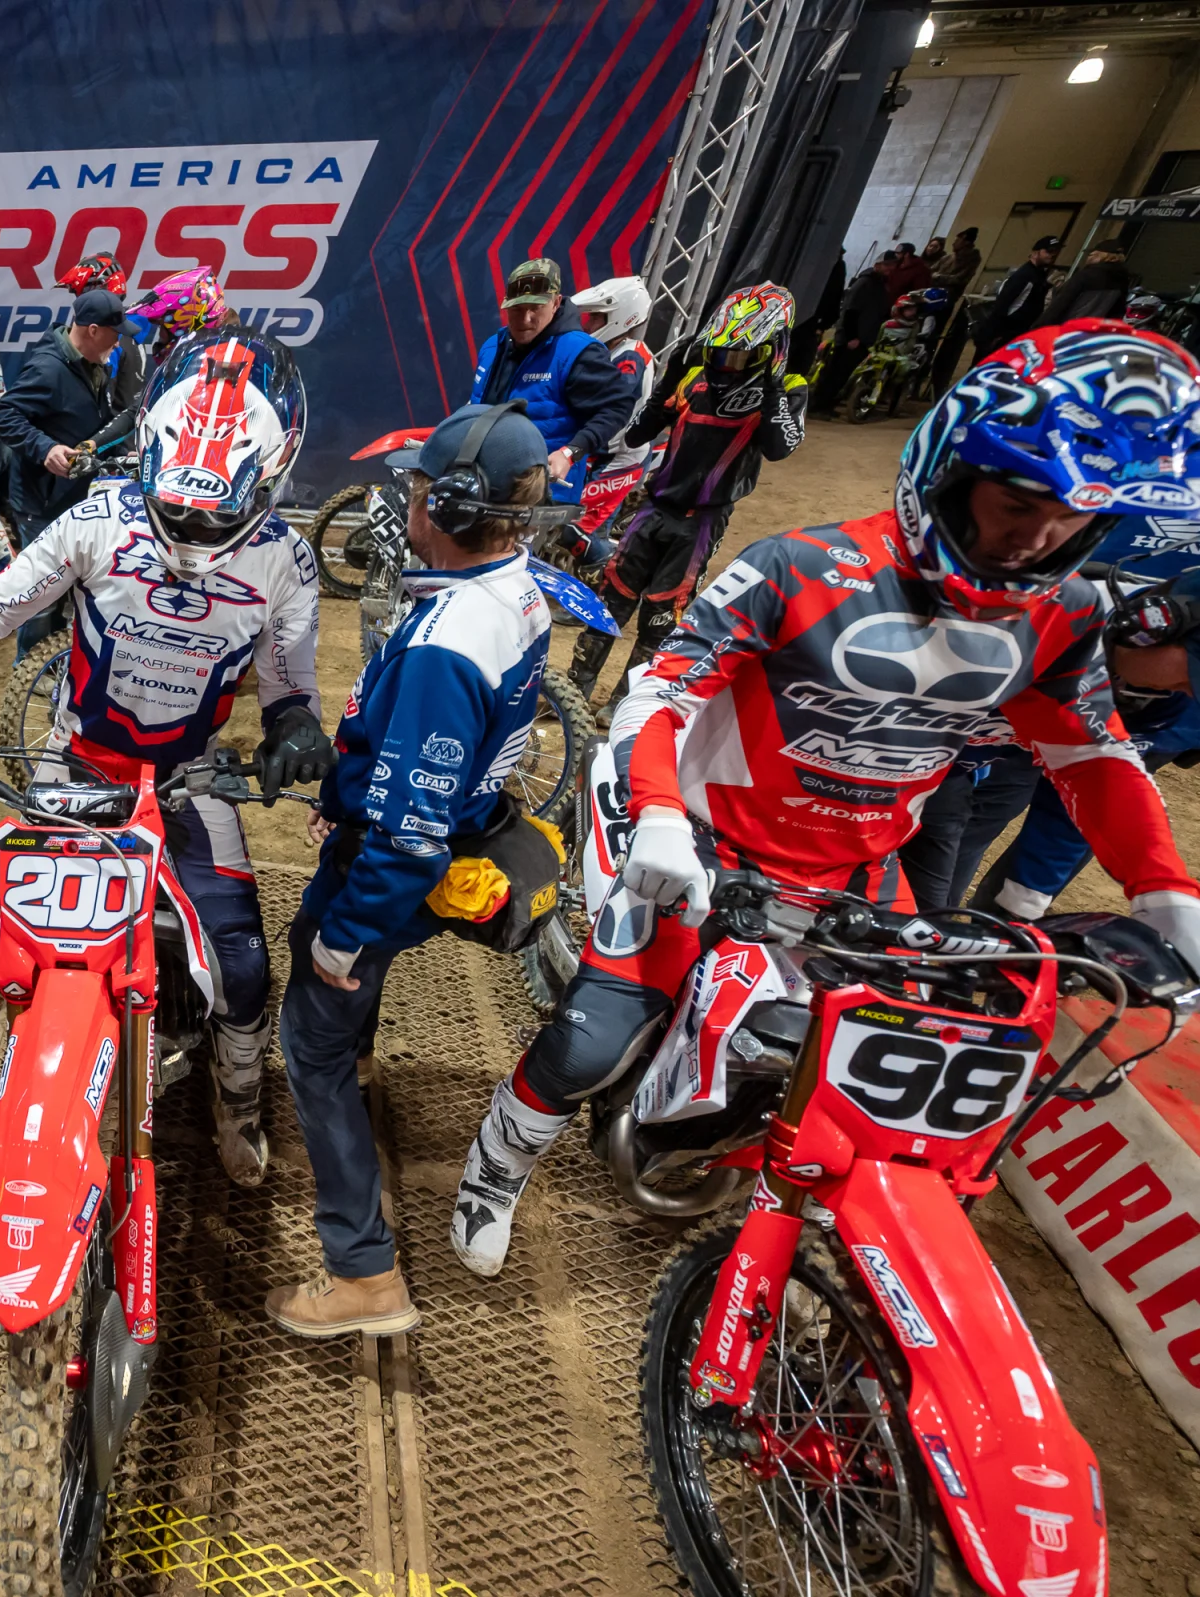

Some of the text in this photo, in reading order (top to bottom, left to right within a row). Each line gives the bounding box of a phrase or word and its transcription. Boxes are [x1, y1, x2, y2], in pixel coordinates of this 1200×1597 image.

[27, 157, 344, 192] AMERICA
[1101, 198, 1148, 216] ASV
[530, 372, 553, 381] YAMAHA
[170, 467, 223, 492] Arai
[834, 548, 864, 566] Arai
[1130, 534, 1200, 555] HON
[422, 595, 450, 642] DUNLOP
[111, 614, 229, 655] MCR
[115, 649, 196, 674] SMARTOP
[272, 617, 298, 690] SMARTP
[123, 691, 157, 704] QUANTUM
[131, 675, 199, 697] HONDA
[800, 730, 958, 773] MCR
[416, 774, 451, 790] AFAM
[800, 776, 897, 800] SMARTOP
[809, 804, 893, 822] HONDA
[12, 838, 36, 846] KICKER
[4, 855, 149, 931] 200
[864, 1009, 905, 1025] KICKER
[86, 1037, 115, 1110] MCR
[838, 1033, 1027, 1134] 98
[142, 1204, 154, 1296] DUNLOP
[860, 1246, 937, 1347] MCR
[715, 1269, 749, 1366] DUNLOP
